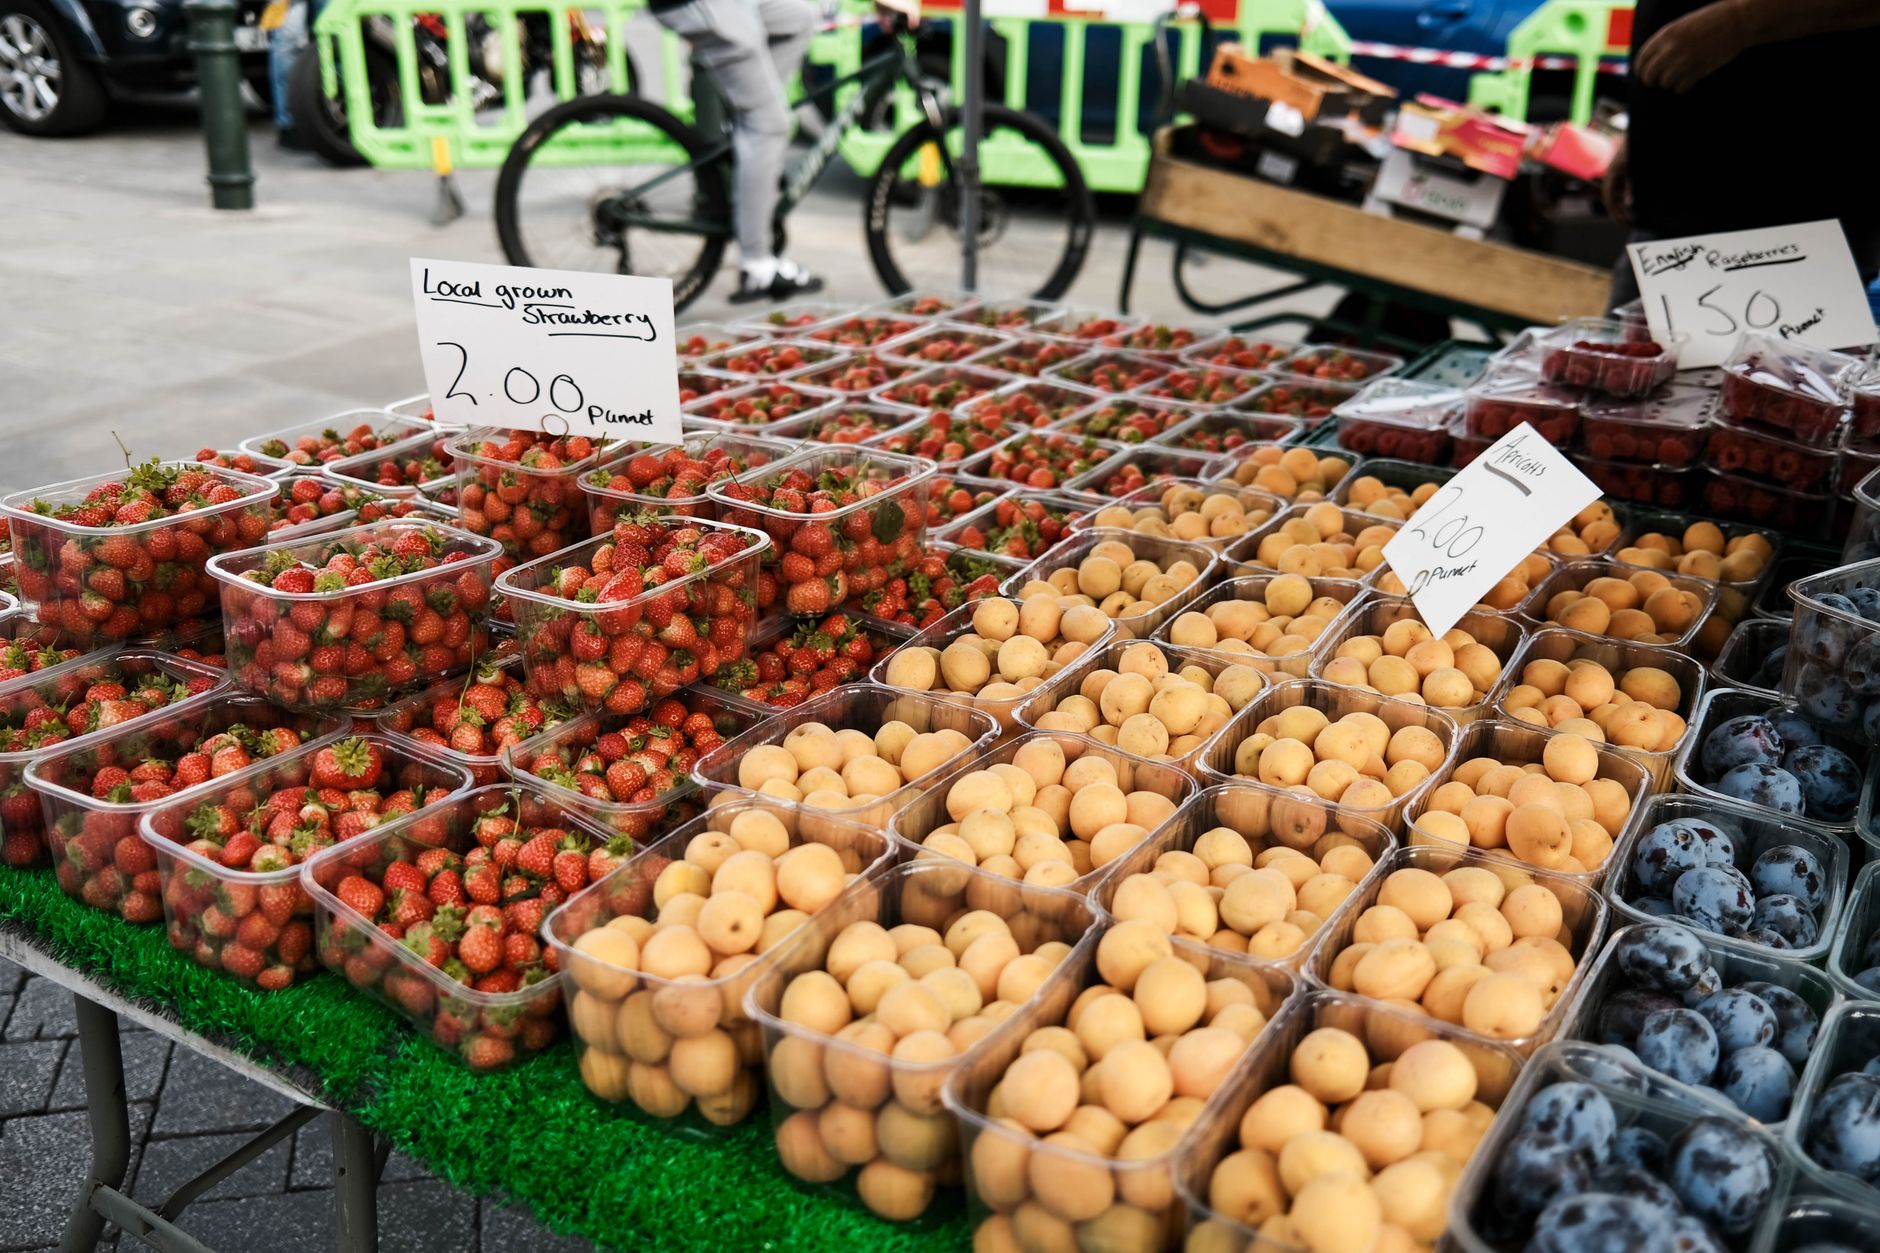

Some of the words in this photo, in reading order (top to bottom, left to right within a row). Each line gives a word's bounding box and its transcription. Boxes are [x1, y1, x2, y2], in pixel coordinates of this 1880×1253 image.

[1637, 244, 1705, 276] English
[1706, 243, 1799, 269] Raspberries
[423, 268, 482, 298] Local
[495, 284, 573, 310] grown
[522, 304, 657, 341] Strawberry
[437, 342, 584, 413] 2.00
[588, 405, 654, 426] Punnet
